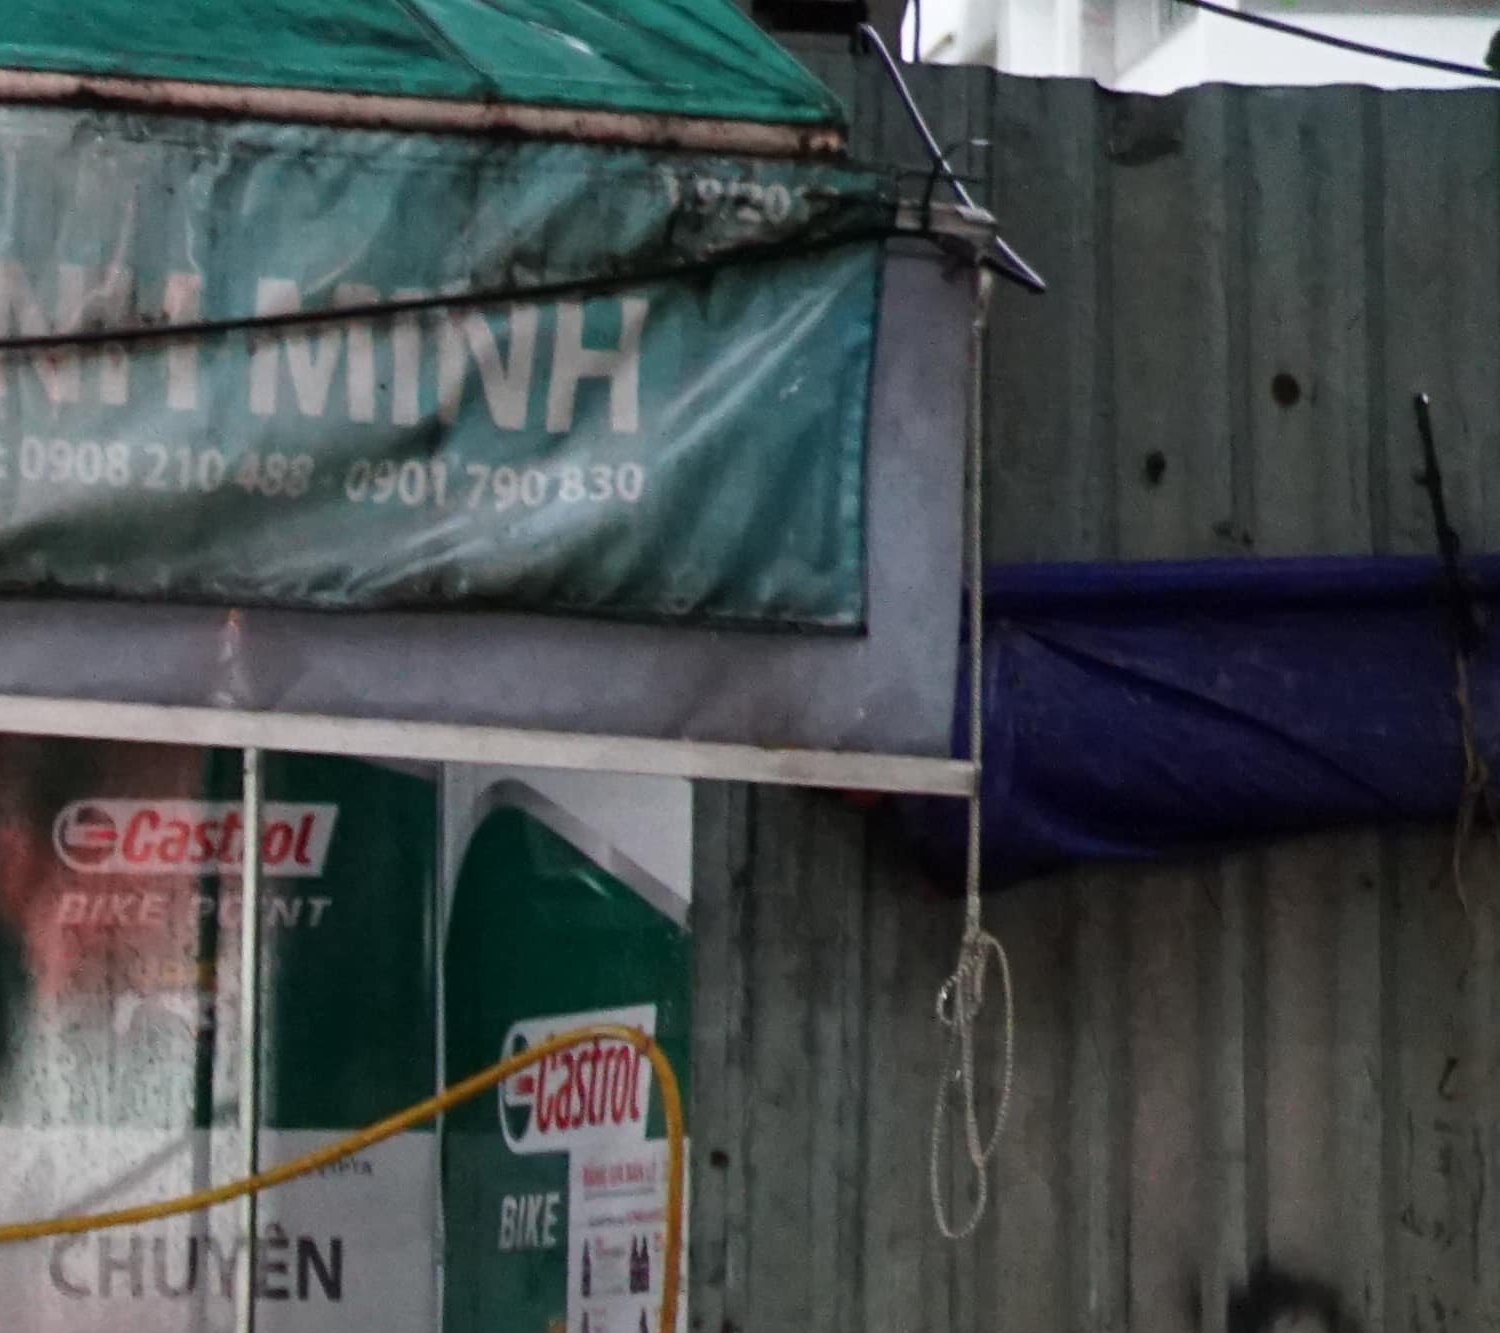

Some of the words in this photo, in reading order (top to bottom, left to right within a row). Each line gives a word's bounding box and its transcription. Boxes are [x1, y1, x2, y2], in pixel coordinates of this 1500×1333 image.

[247, 276, 649, 434] MINH
[18, 434, 130, 487] 0908
[557, 461, 645, 503] 830
[122, 808, 317, 868] Castol
[56, 892, 167, 927] BIKE
[190, 894, 333, 928] PONT
[500, 1190, 561, 1251] BIKE
